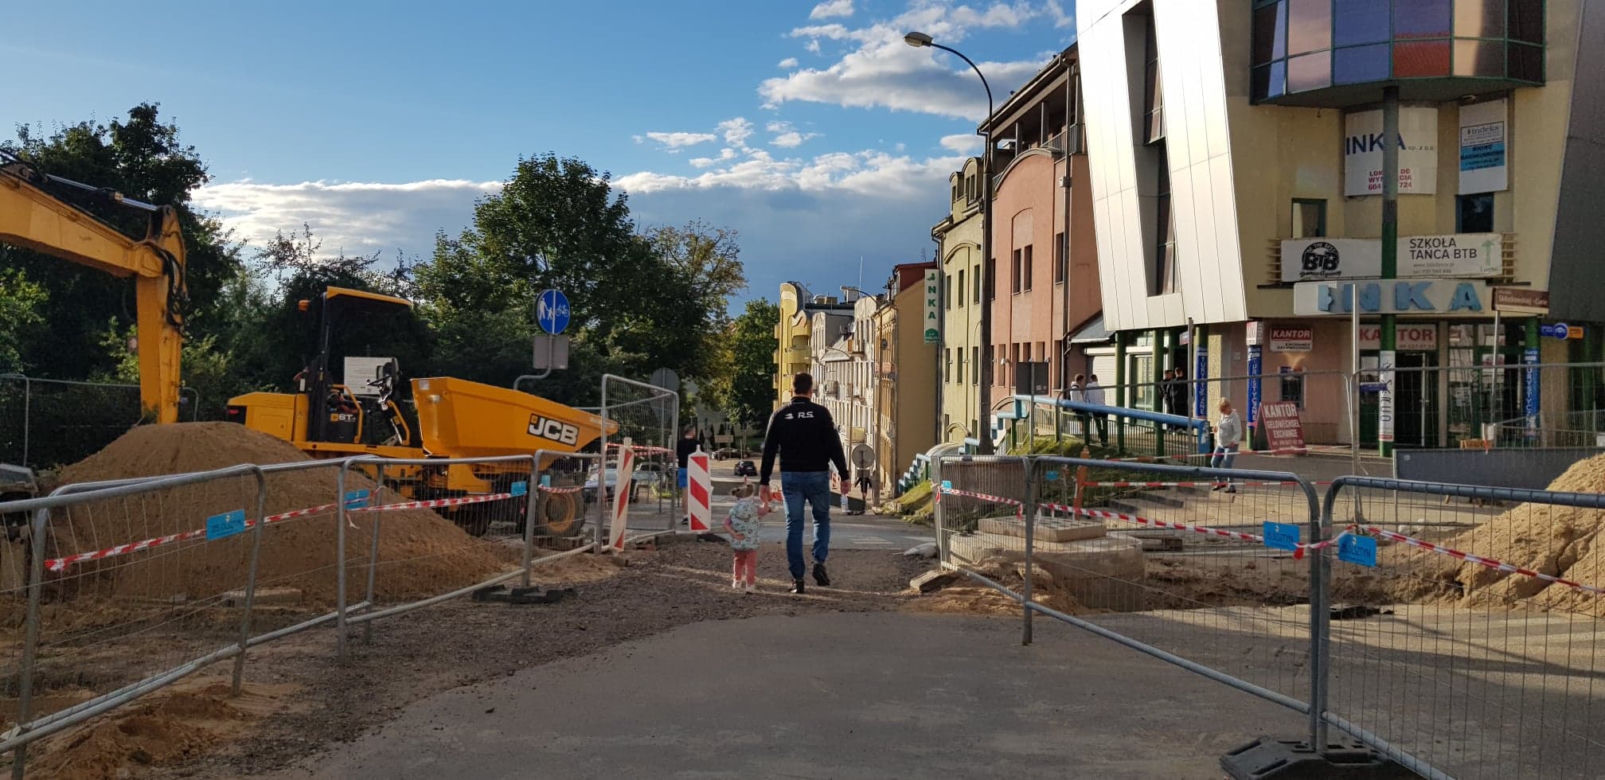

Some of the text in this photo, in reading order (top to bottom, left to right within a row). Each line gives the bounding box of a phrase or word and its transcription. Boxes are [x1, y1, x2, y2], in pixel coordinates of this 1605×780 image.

[1409, 237, 1457, 249] SZKOŁA
[1409, 247, 1478, 260] TAŃCA BTB
[1303, 251, 1338, 271] BTB
[1273, 330, 1311, 339] KANTOR
[1359, 328, 1433, 341] KATOR
[1263, 404, 1298, 418] KANTOR
[529, 416, 579, 445] JCB
